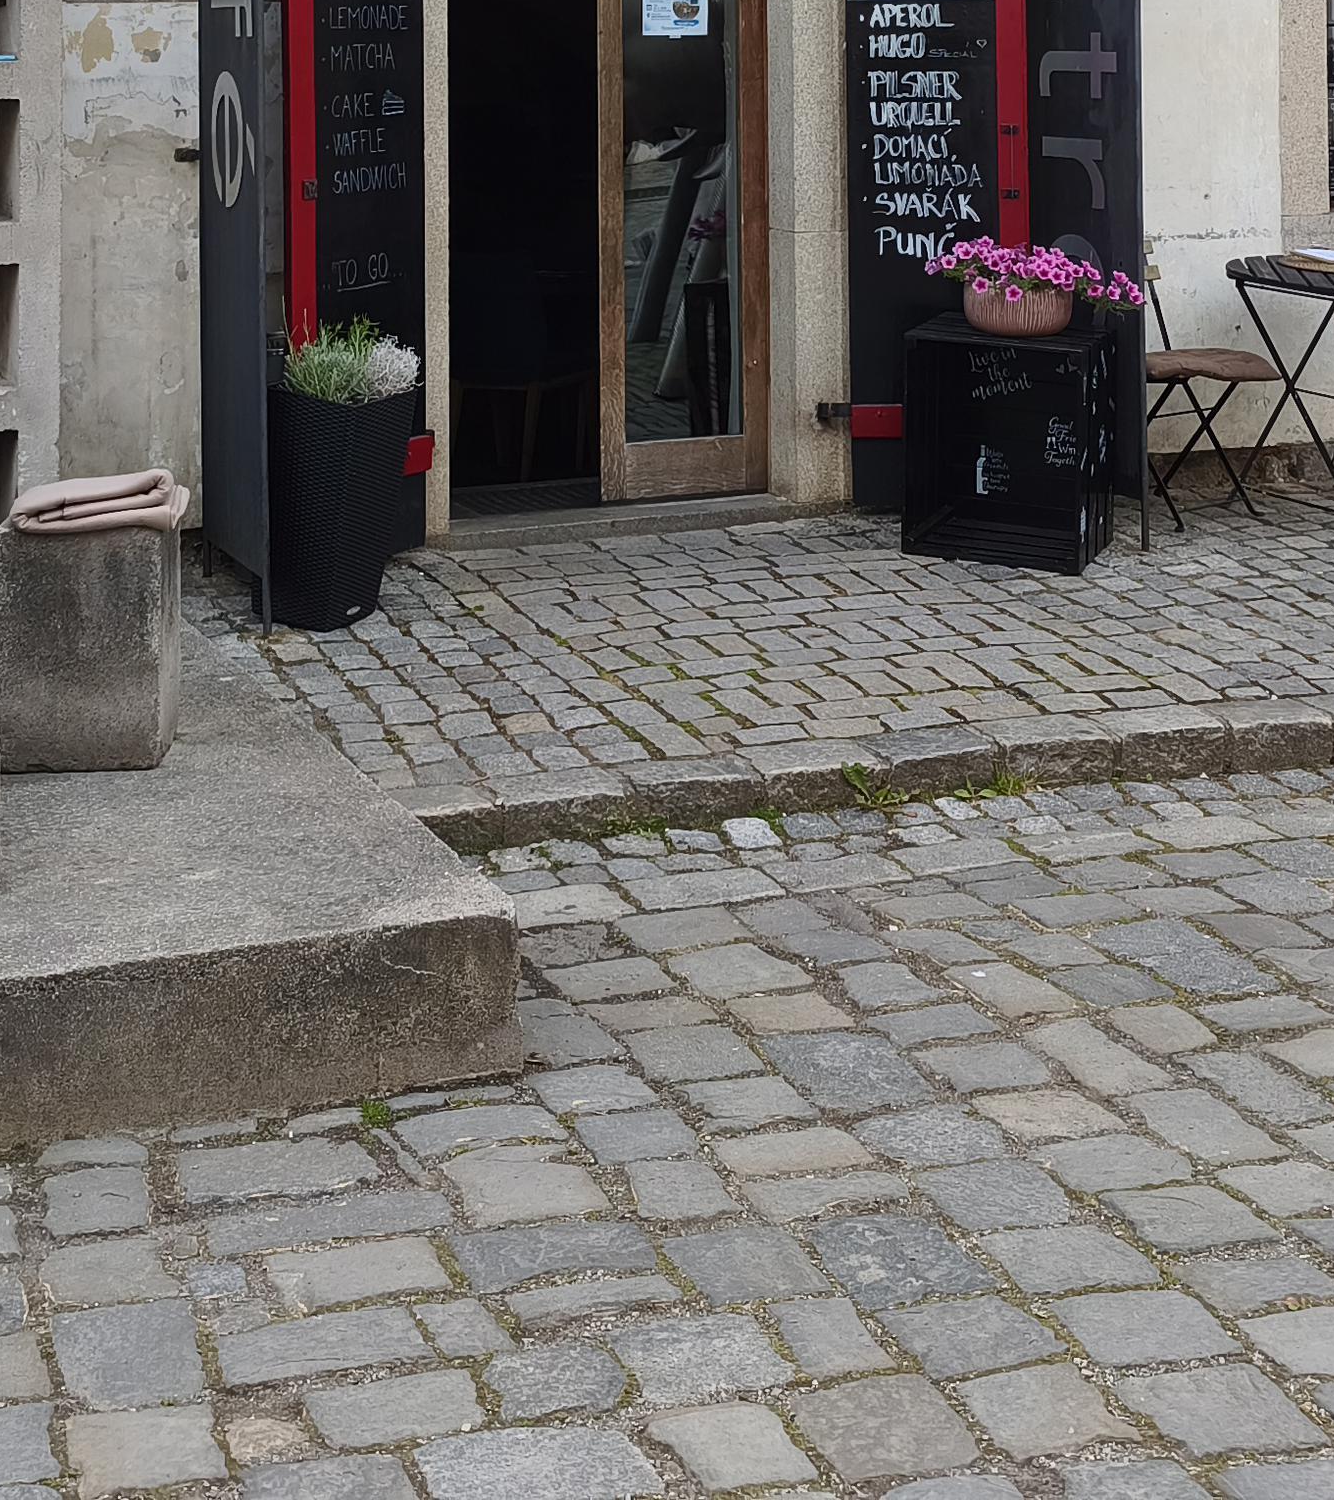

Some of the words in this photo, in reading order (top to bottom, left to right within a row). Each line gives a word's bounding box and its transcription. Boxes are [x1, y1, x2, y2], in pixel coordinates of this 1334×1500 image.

[329, 4, 409, 31] LEMONADE
[869, 3, 955, 29] APEROL
[330, 43, 396, 72] MATCHA
[868, 32, 926, 59] HUGO
[868, 70, 962, 100] PILSNER
[331, 92, 375, 118] CAKE
[869, 101, 961, 131] URQUELL
[332, 127, 386, 156] WAFFLE
[332, 162, 407, 194] SANDWICH
[872, 188, 980, 223] SVAŘÁK
[971, 371, 1033, 401] moment
